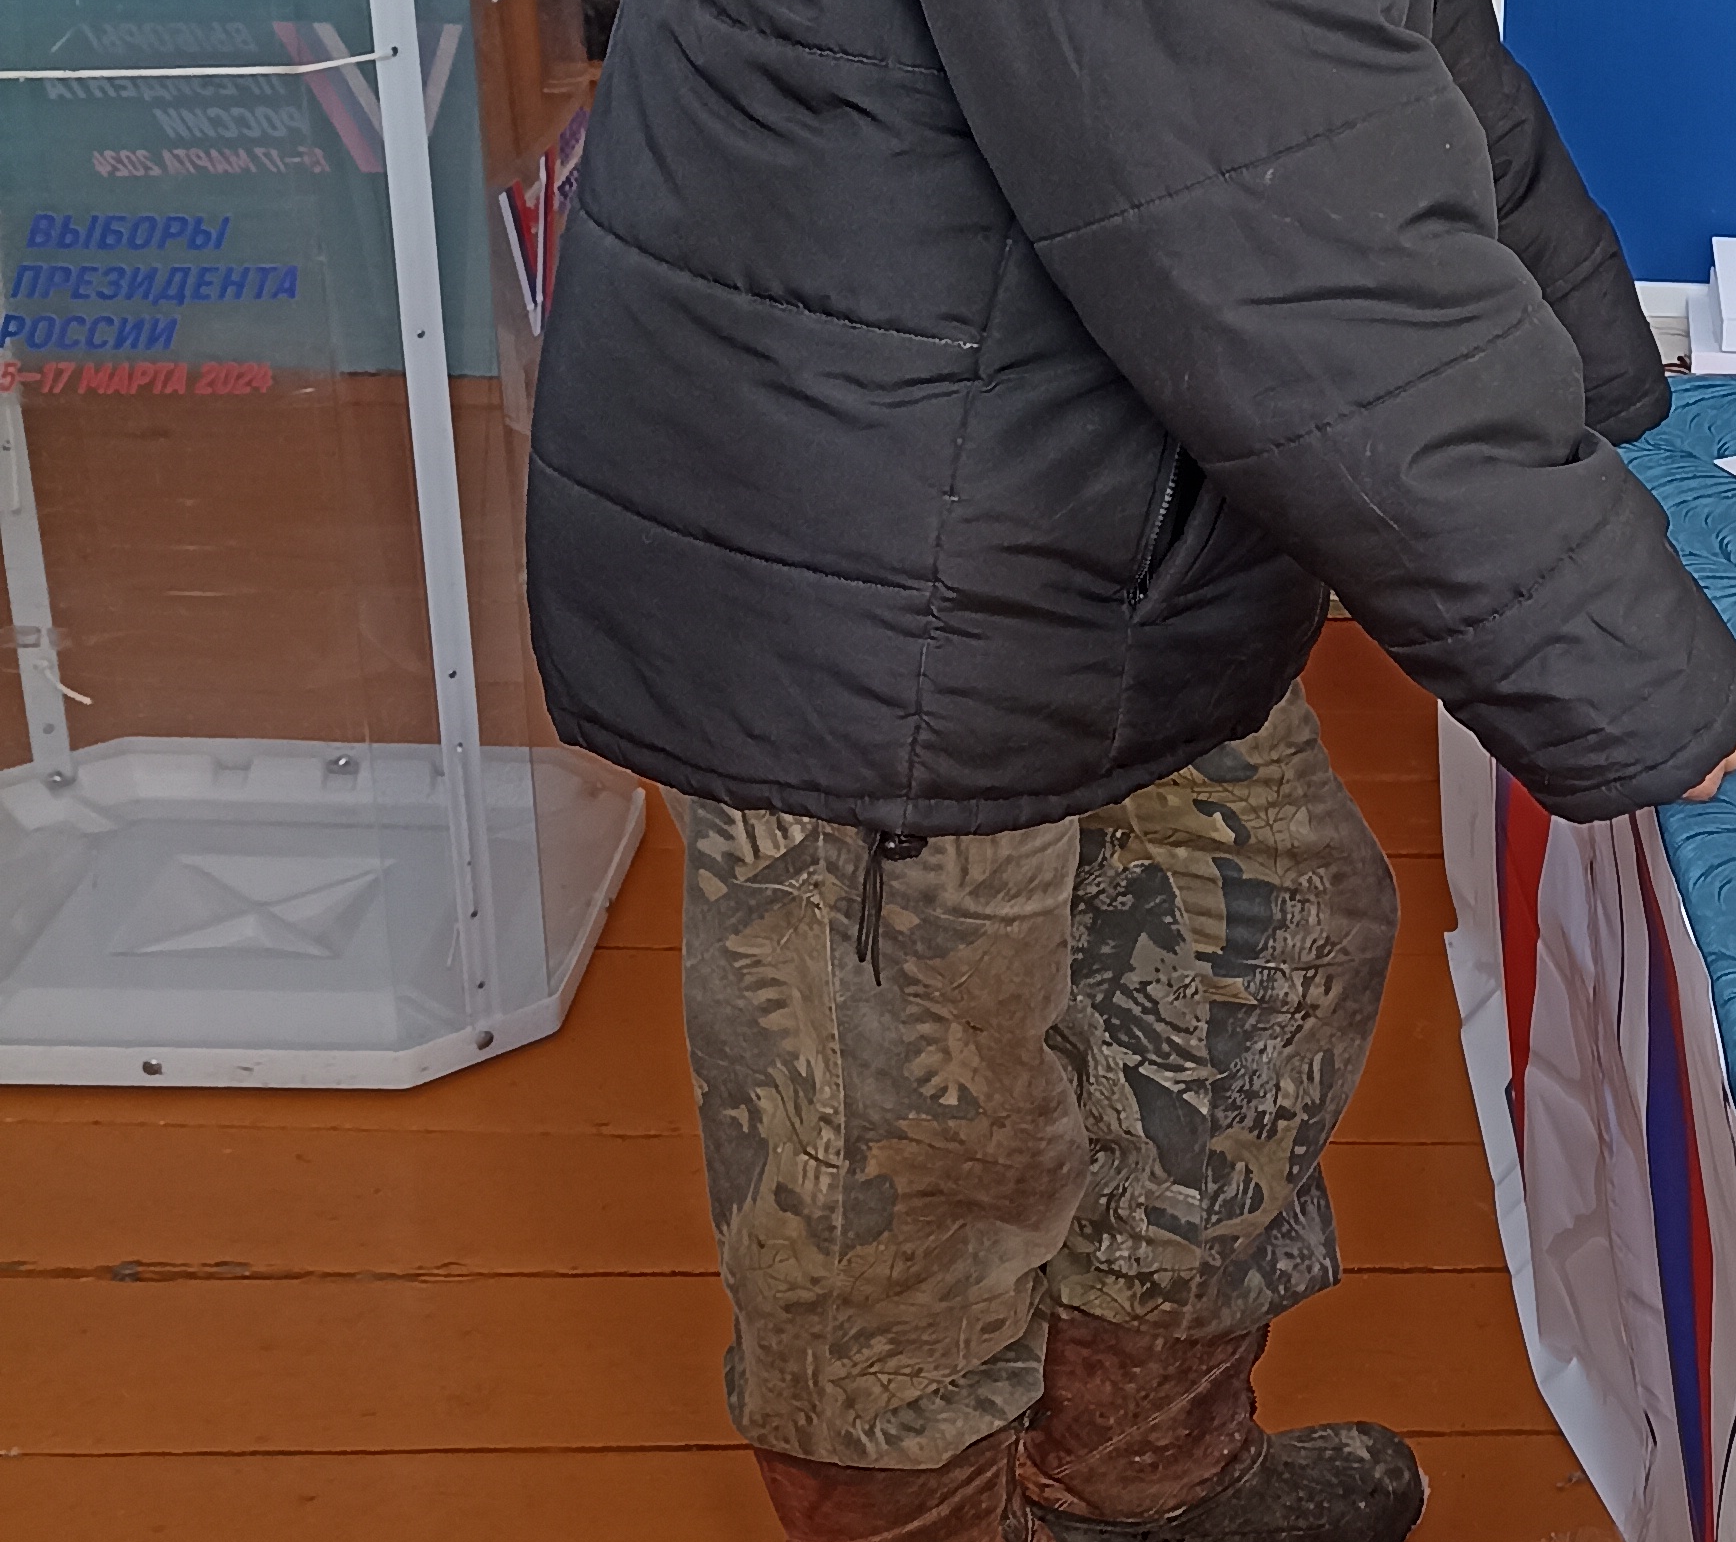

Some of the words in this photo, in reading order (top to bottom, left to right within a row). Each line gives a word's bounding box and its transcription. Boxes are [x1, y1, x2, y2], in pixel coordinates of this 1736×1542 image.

[26, 212, 231, 251] ВЫБОРЫ
[10, 263, 299, 307] ПРЕЗИДЕНТА
[0, 313, 180, 351] РОССИИ
[77, 361, 189, 395] МАРТА
[194, 361, 274, 395] 2024
